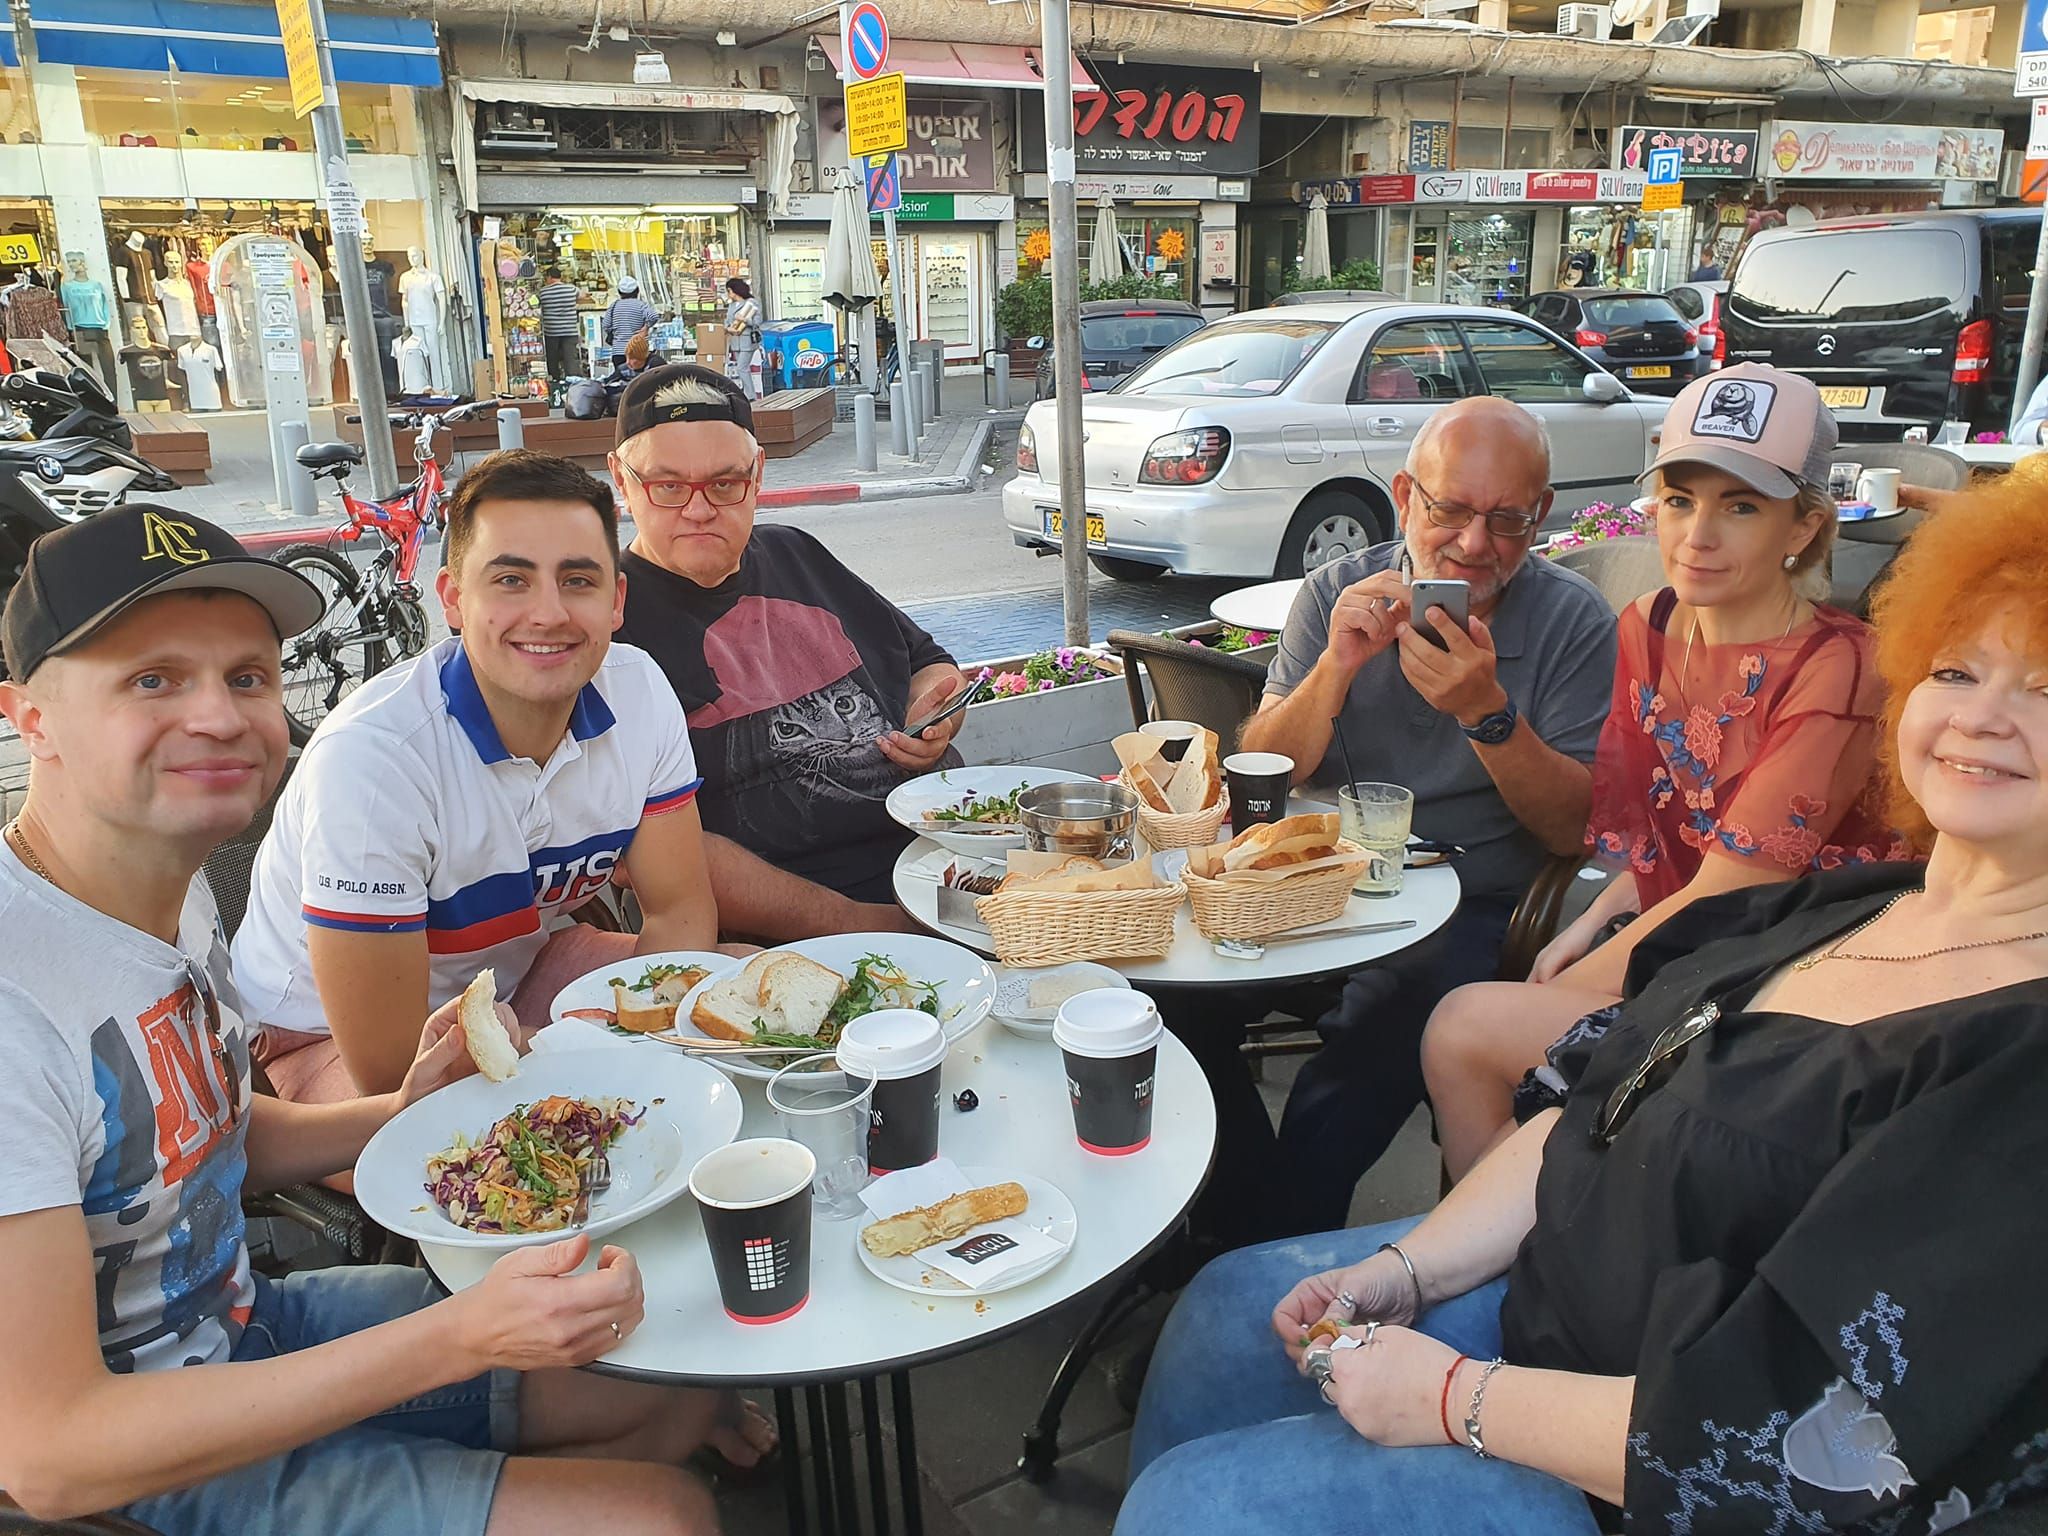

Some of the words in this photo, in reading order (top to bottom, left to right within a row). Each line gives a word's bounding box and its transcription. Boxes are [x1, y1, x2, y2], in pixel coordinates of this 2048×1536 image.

[1074, 89, 1245, 142] הסנדק
[896, 200, 927, 213] ision
[6, 244, 28, 260] 39
[1034, 244, 1044, 256] 19
[1167, 242, 1178, 254] 20
[1214, 263, 1224, 274] 10
[1824, 390, 1862, 403] 77-501
[1701, 423, 1736, 432] BEAVER
[1248, 800, 1271, 812] ארומה
[336, 879, 368, 894] POLO
[371, 882, 408, 895] ASSN.
